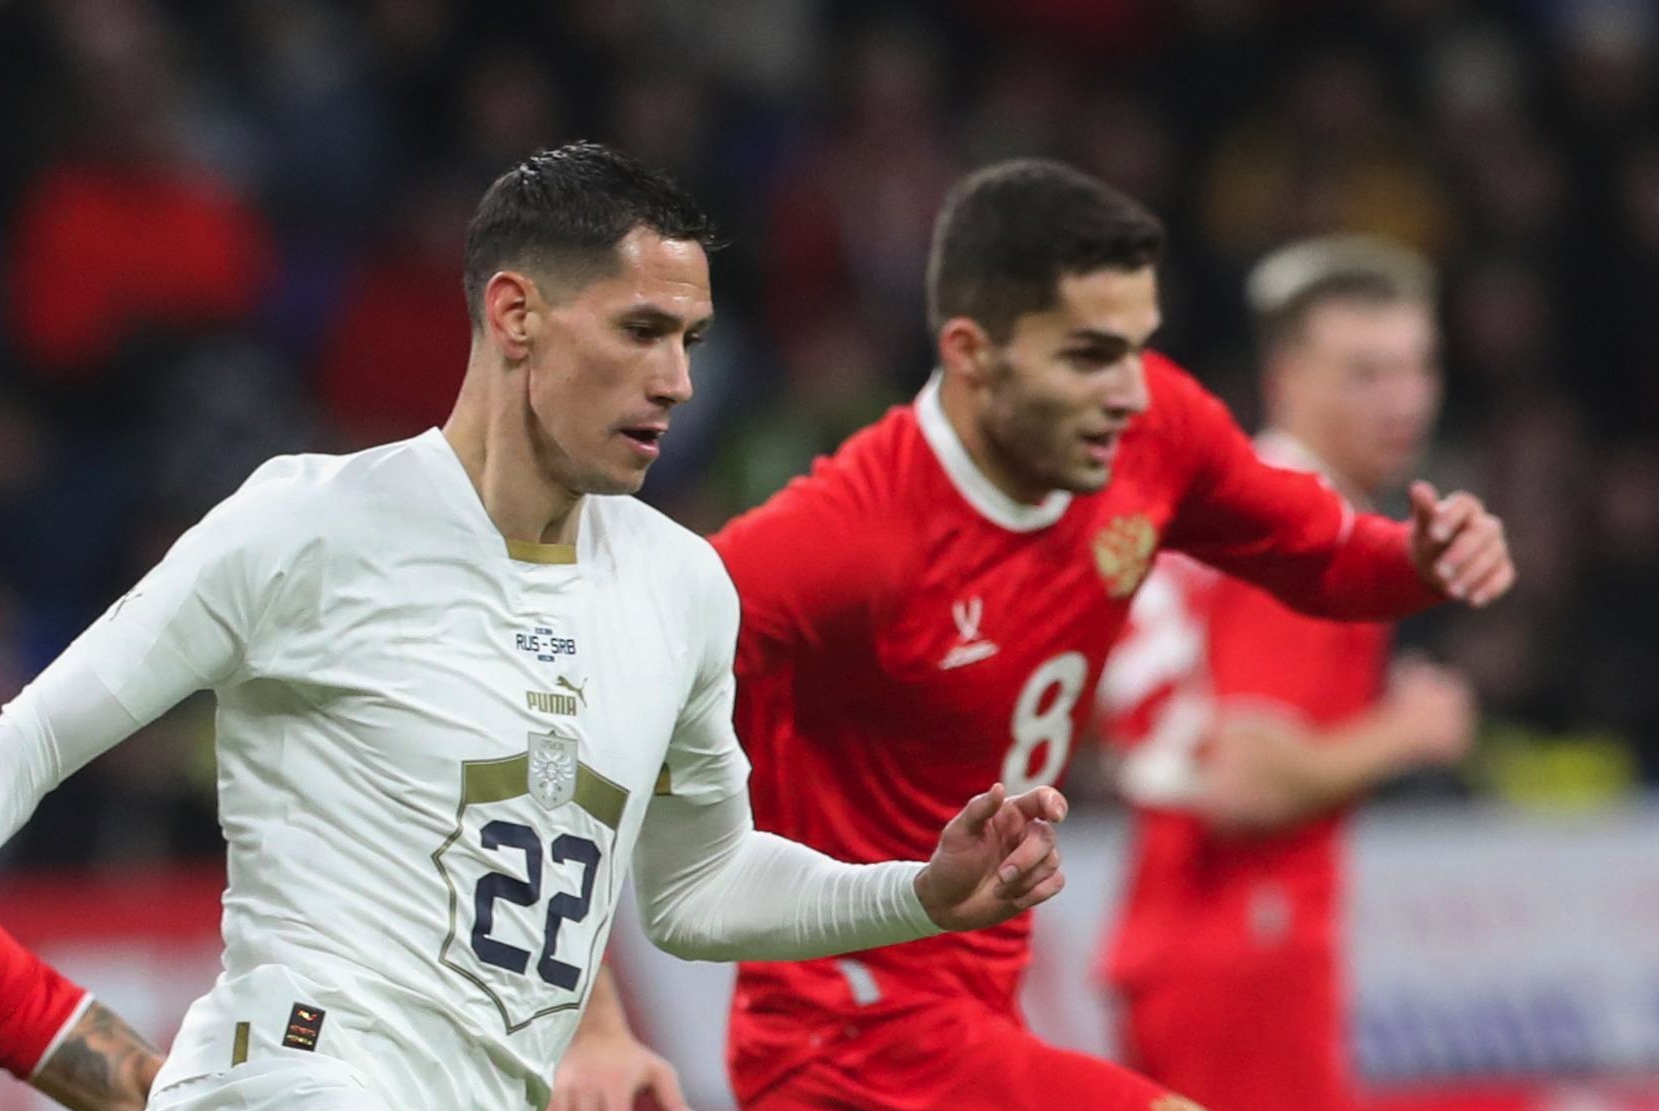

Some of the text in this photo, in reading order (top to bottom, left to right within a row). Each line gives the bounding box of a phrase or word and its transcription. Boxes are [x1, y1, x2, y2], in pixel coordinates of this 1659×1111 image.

[516, 634, 540, 652] RUS
[550, 637, 577, 655] SRB
[526, 691, 577, 716] PUMA
[1001, 651, 1088, 798] 8
[471, 819, 602, 992] 22
